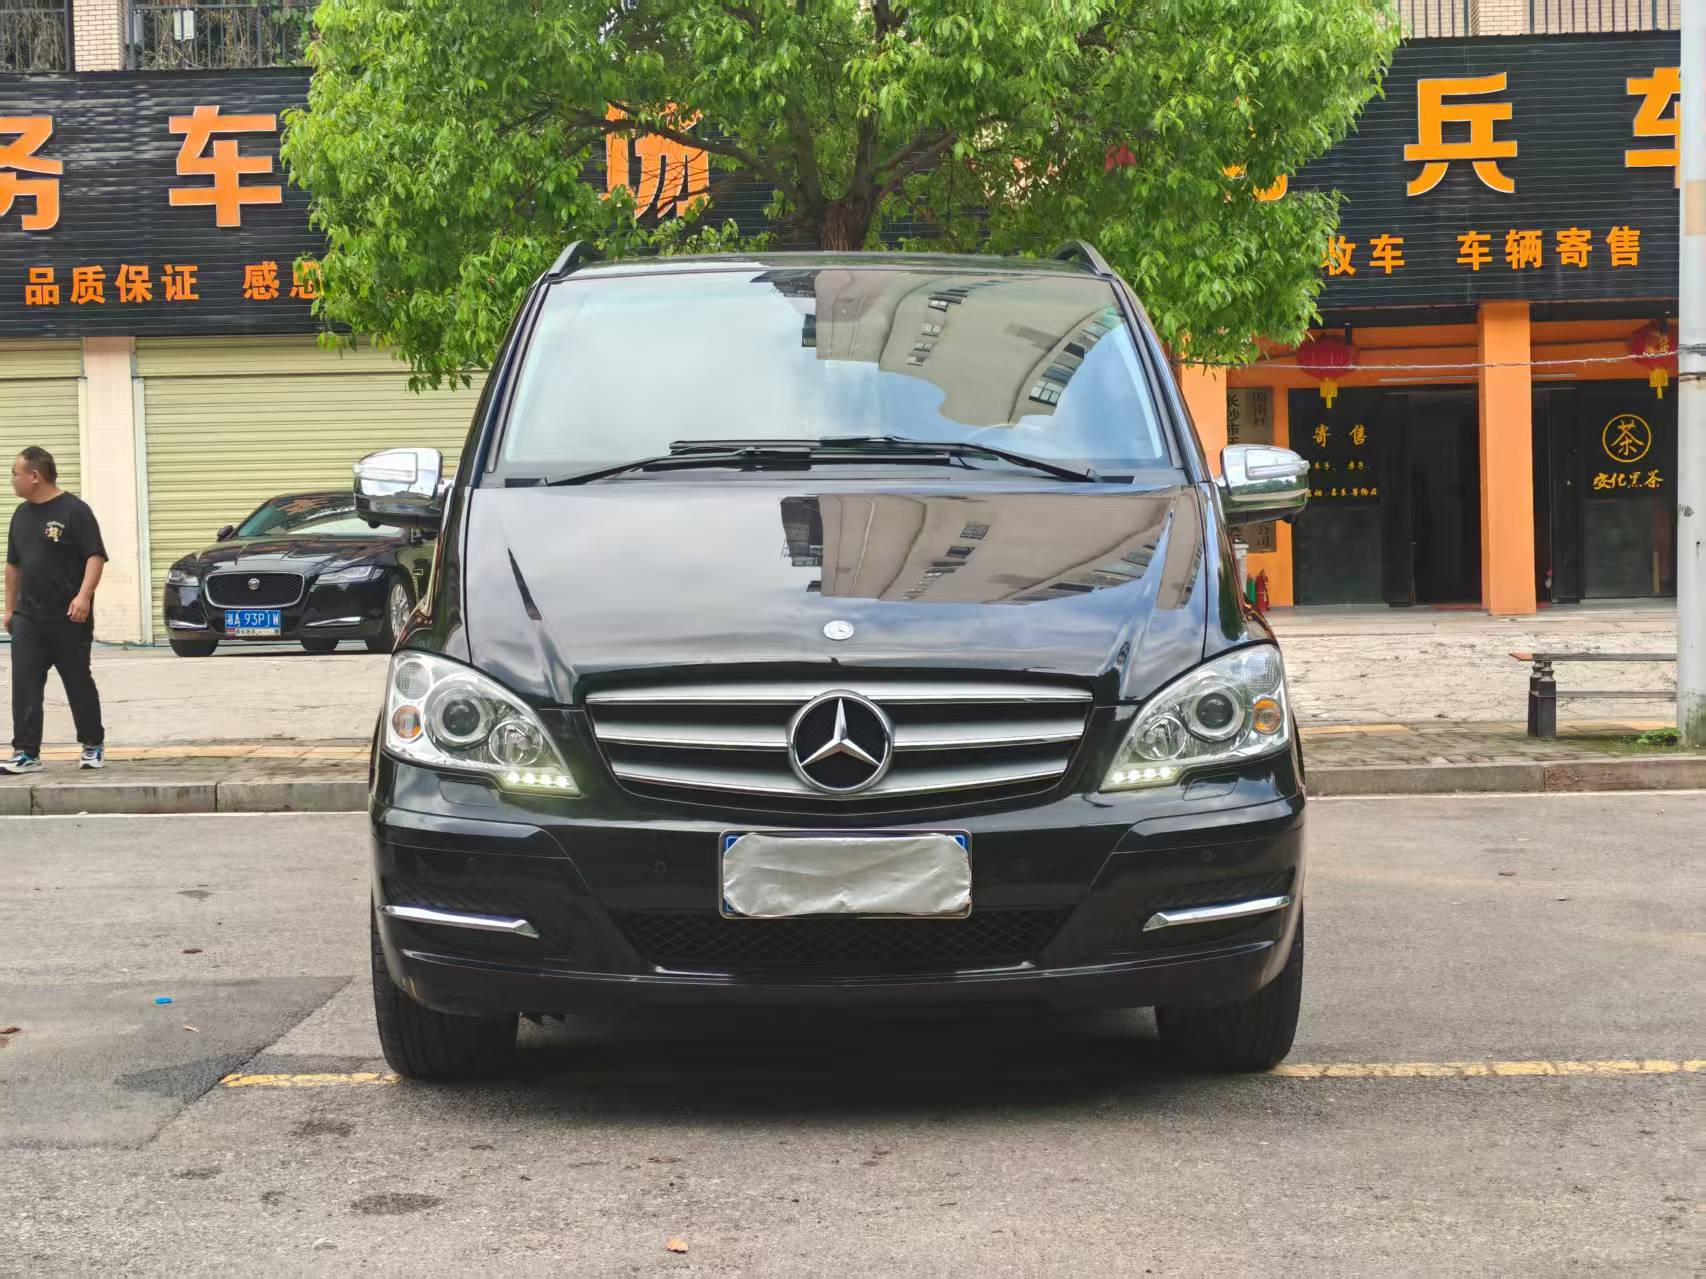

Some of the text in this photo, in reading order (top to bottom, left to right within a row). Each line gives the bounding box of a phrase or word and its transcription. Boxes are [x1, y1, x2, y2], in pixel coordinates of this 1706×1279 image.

[1455, 225, 1642, 271] 车辆寄售
[24, 263, 200, 306] 品质保证
[1312, 423, 1368, 448] 寄售
[1610, 419, 1645, 456] 茶
